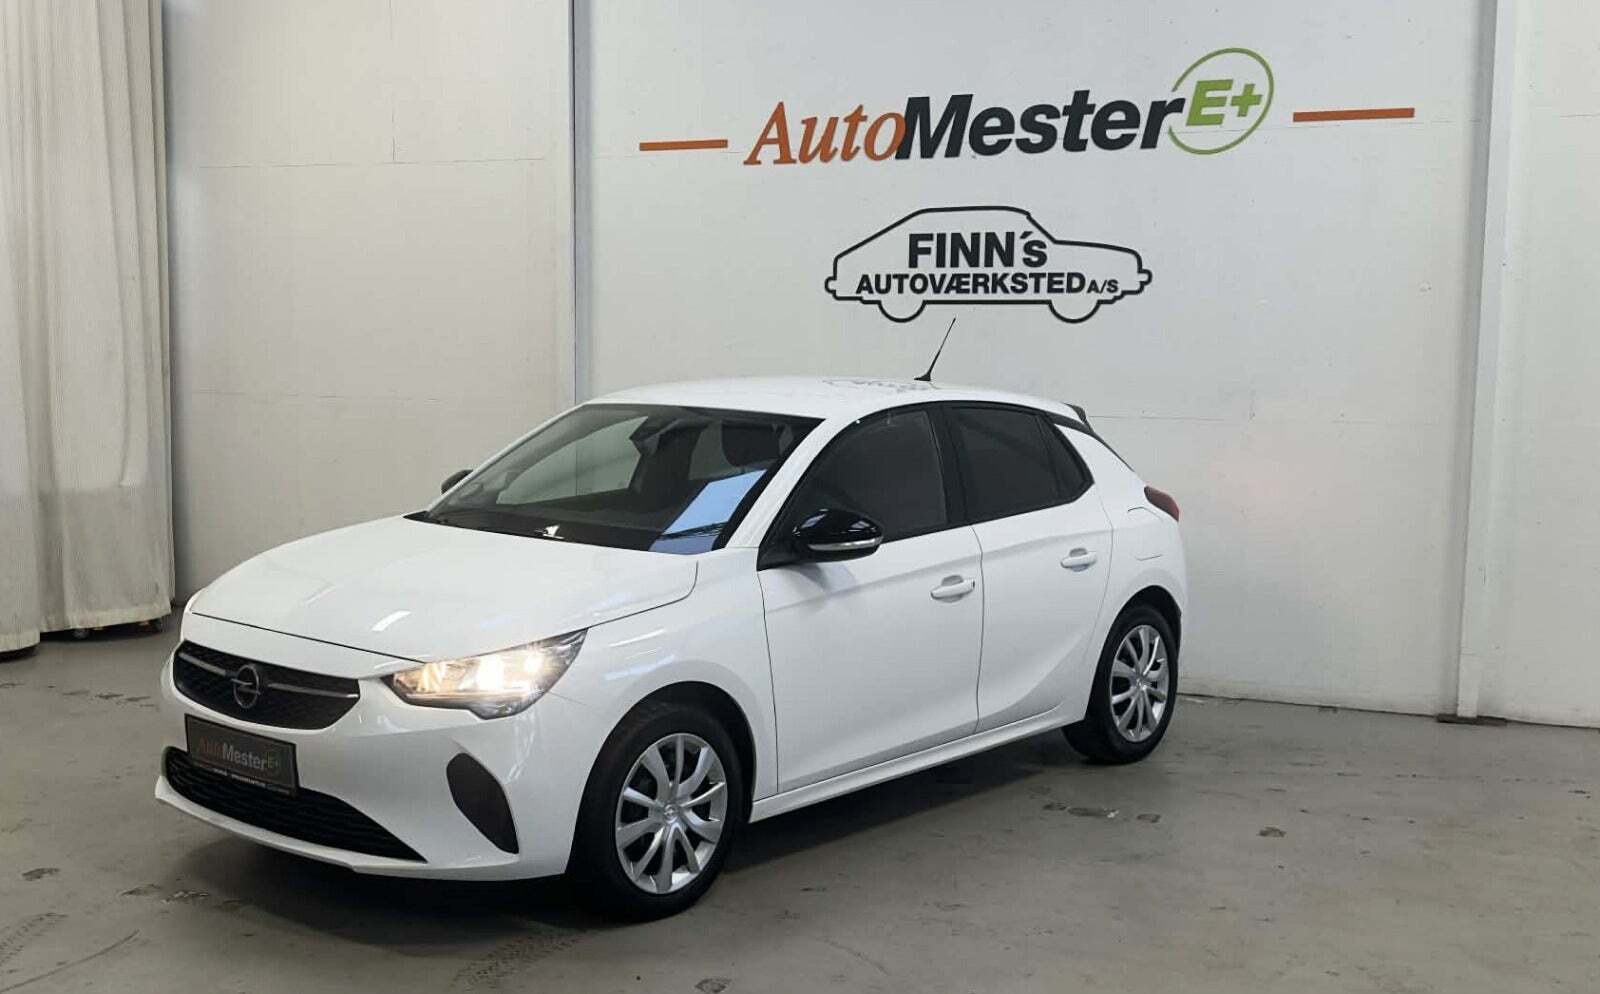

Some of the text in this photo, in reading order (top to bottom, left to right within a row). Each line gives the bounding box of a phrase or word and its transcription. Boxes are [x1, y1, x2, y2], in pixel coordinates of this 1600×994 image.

[743, 90, 1185, 165] AutoMester
[855, 272, 1119, 295] AUTOVÆRKSTED A/S
